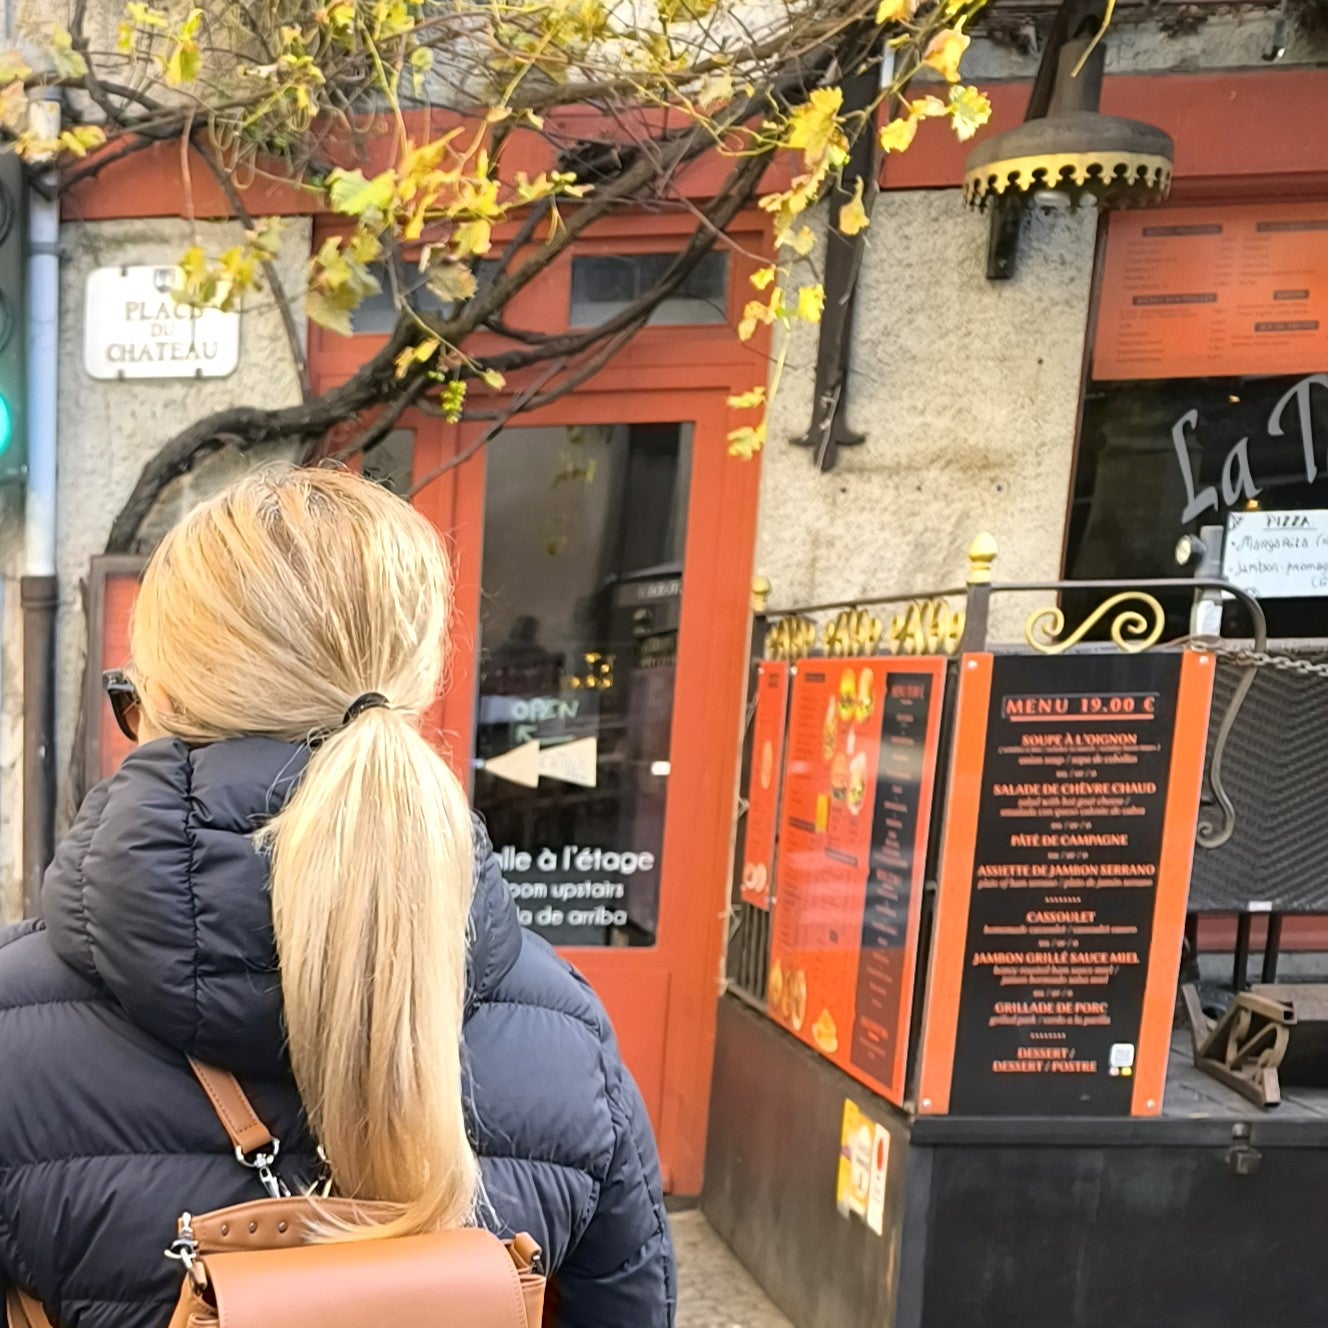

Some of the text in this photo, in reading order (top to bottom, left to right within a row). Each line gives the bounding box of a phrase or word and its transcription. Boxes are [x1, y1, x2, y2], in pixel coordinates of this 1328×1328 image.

[151, 323, 174, 337] DU
[106, 342, 218, 363] CHATEAU
[1172, 409, 1264, 525] La
[512, 698, 580, 721] OPEN
[1006, 697, 1069, 714] MENU
[1080, 697, 1135, 713] 19.00
[1022, 733, 1063, 746] SOUPE
[1076, 733, 1138, 745] L'OIGNON
[993, 781, 1157, 796] SALADE DE CHÈVRE CHAUD
[1042, 834, 1059, 847] DE
[1060, 834, 1129, 847] CAMPAGNE
[536, 847, 557, 872] à
[562, 845, 655, 875] l'étage
[977, 864, 1156, 878] ASSIETTE DE JAMBON SERRANO
[509, 880, 625, 902] oom upstairs
[535, 904, 564, 926] de
[567, 904, 628, 926] arriba
[1026, 911, 1097, 923] CASSOULET
[973, 952, 1023, 966] JAMBON
[1070, 951, 1109, 964] SAUCE
[994, 1001, 1109, 1014] GRILLADE DE PORC
[1017, 1047, 1069, 1059] DESSERT
[992, 1061, 1043, 1072] DESSERT
[1051, 1060, 1097, 1072] POSTRE
